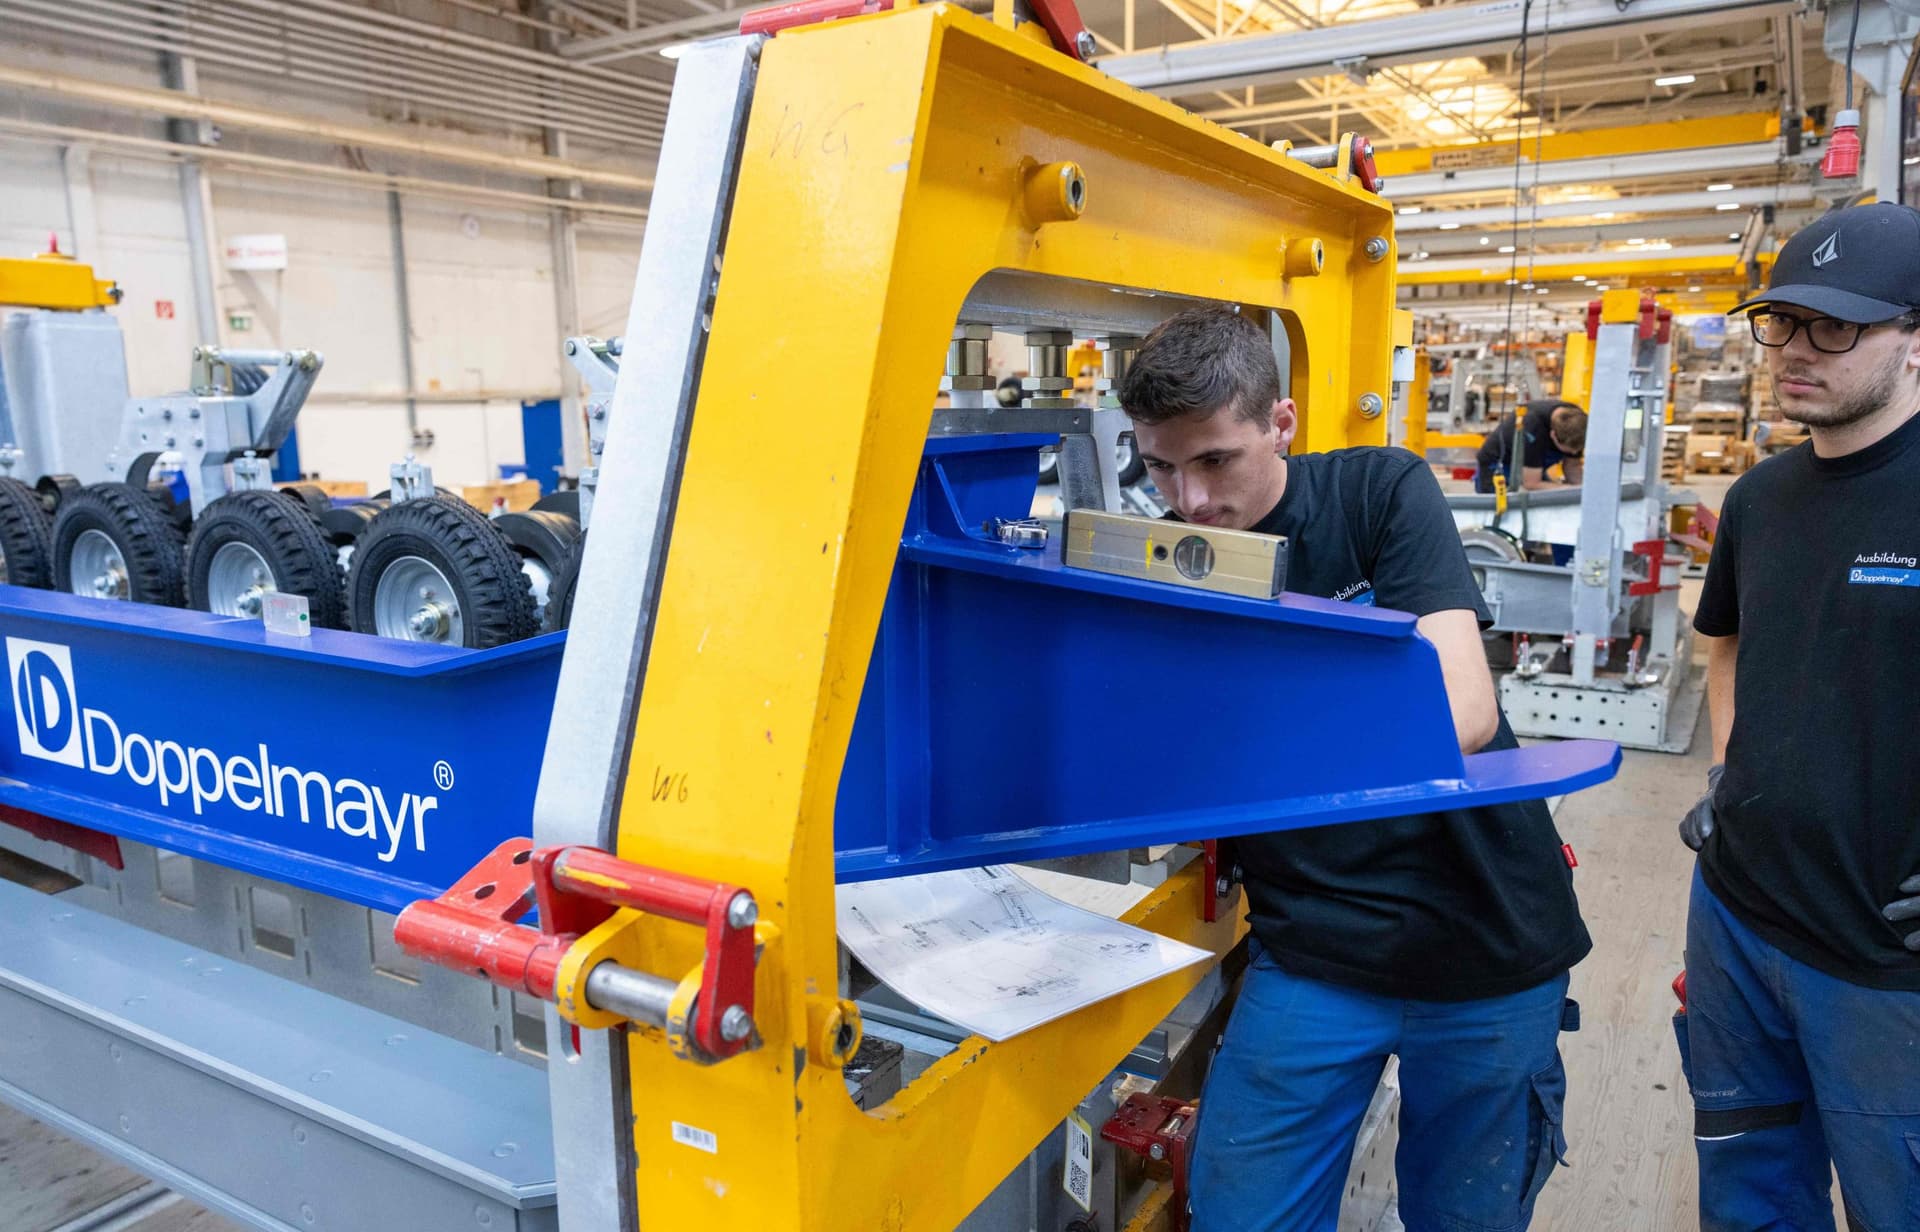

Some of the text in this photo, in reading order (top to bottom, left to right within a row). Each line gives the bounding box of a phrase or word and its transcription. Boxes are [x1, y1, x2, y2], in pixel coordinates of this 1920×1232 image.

[1855, 552, 1917, 567] Ausbildung
[1861, 573, 1905, 585] Doppelmayr
[83, 707, 438, 862] Doppelmayr
